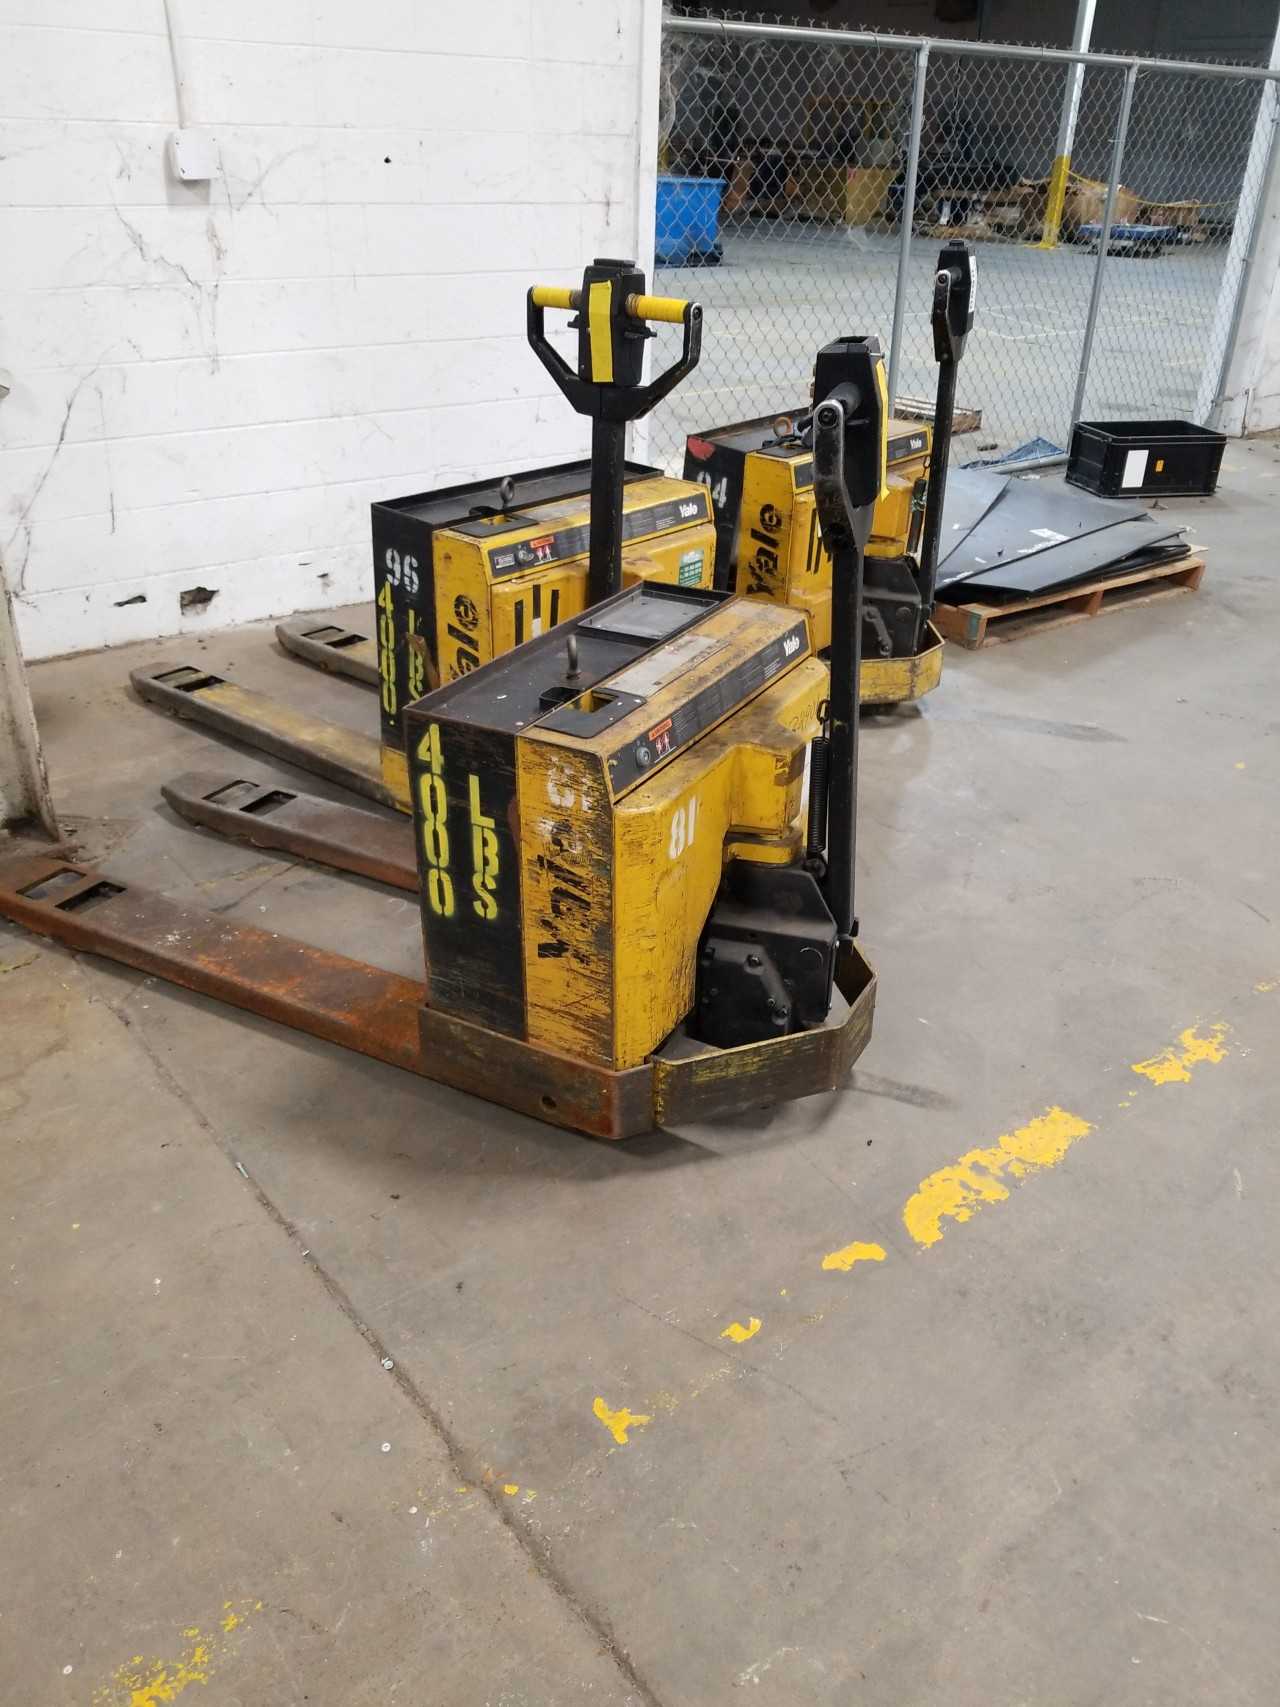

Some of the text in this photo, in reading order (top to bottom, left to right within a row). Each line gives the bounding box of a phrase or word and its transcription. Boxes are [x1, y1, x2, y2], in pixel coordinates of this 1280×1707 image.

[386, 548, 419, 593] 96
[746, 503, 783, 597] Yale
[378, 581, 396, 715] 4000
[447, 594, 480, 680] ale
[417, 723, 455, 919] 4000
[467, 774, 499, 920] LBS
[669, 795, 697, 859] 81
